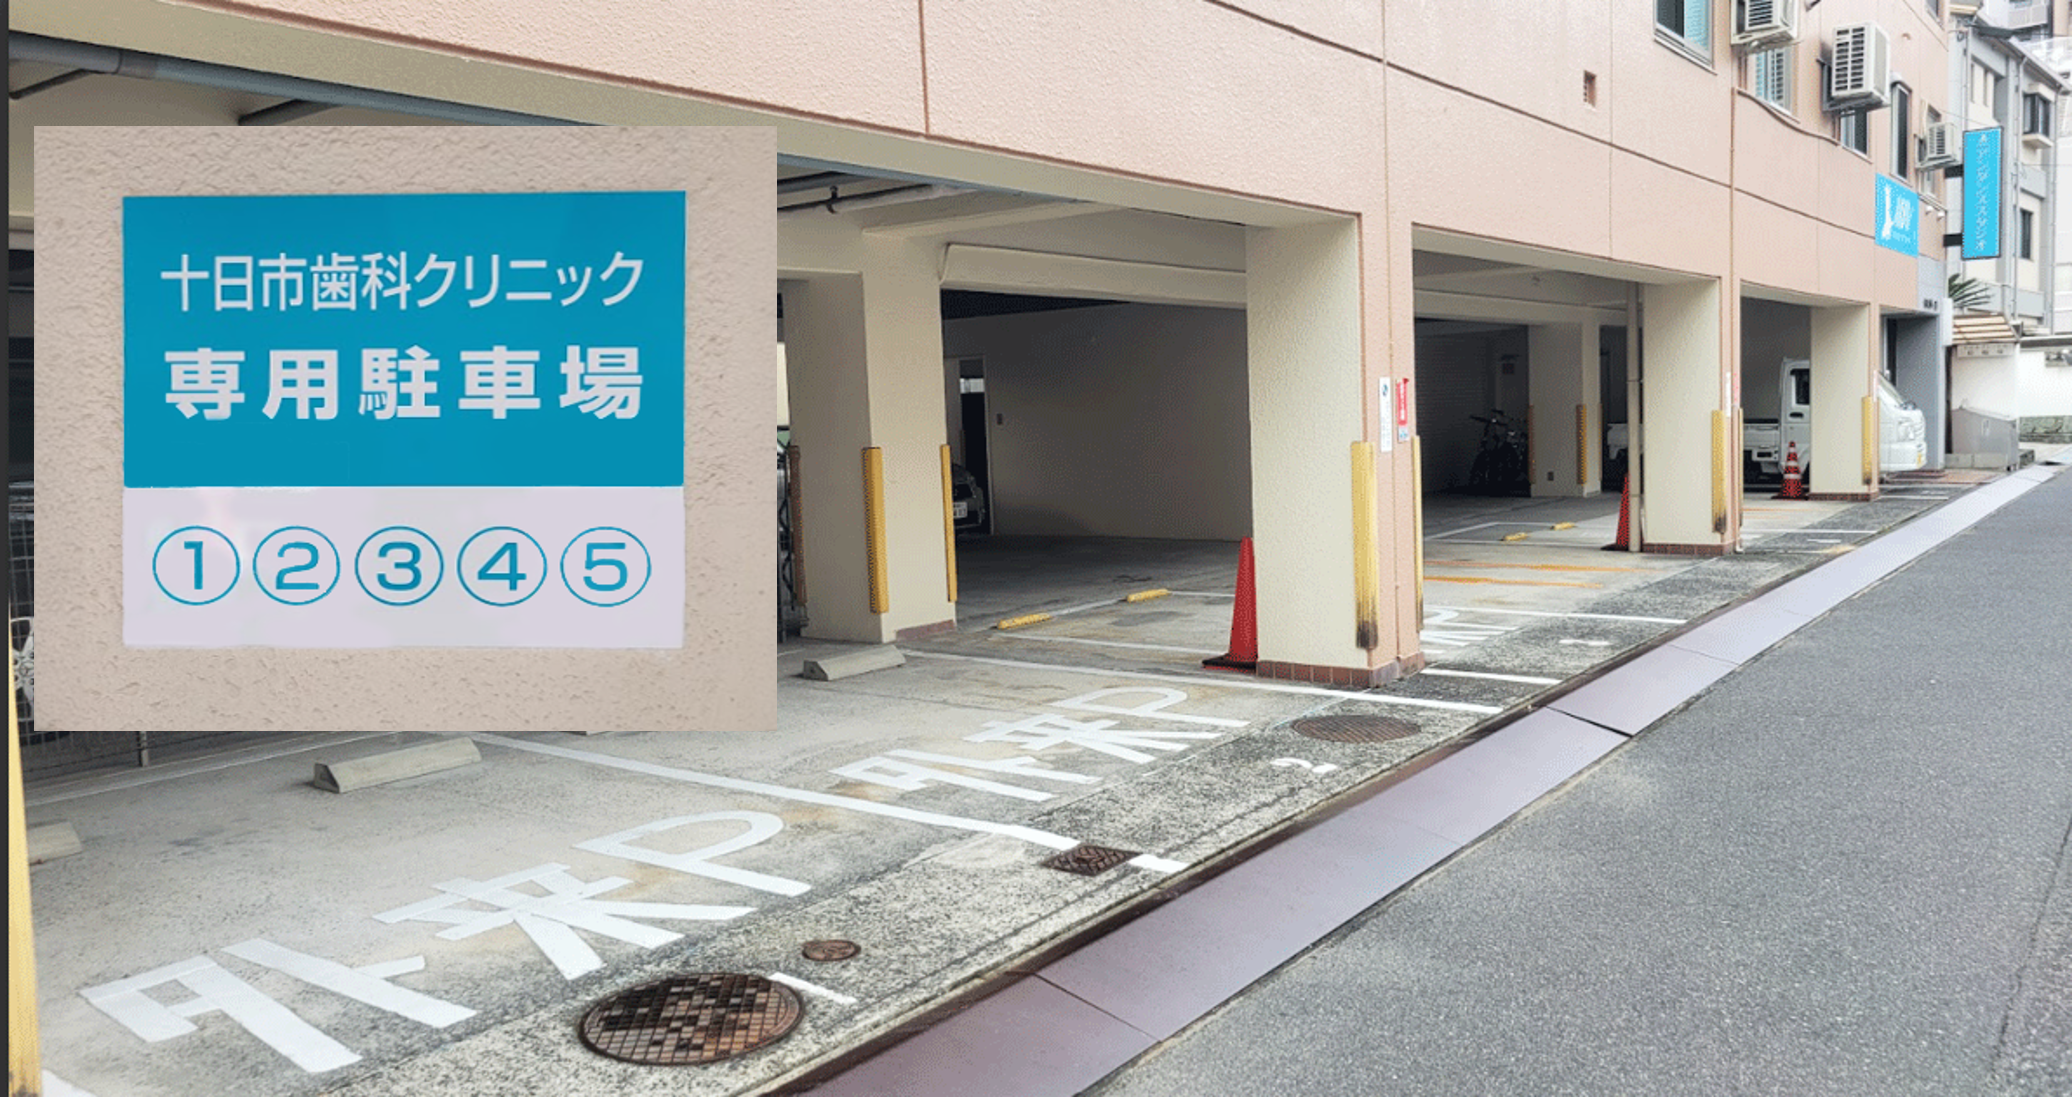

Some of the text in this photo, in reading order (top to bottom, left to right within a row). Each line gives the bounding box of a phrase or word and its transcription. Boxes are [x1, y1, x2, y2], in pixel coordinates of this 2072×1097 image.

[160, 251, 644, 311] 十日市歯科クリニック
[164, 344, 643, 420] 専用駐車場
[79, 810, 812, 1074] 外来P
